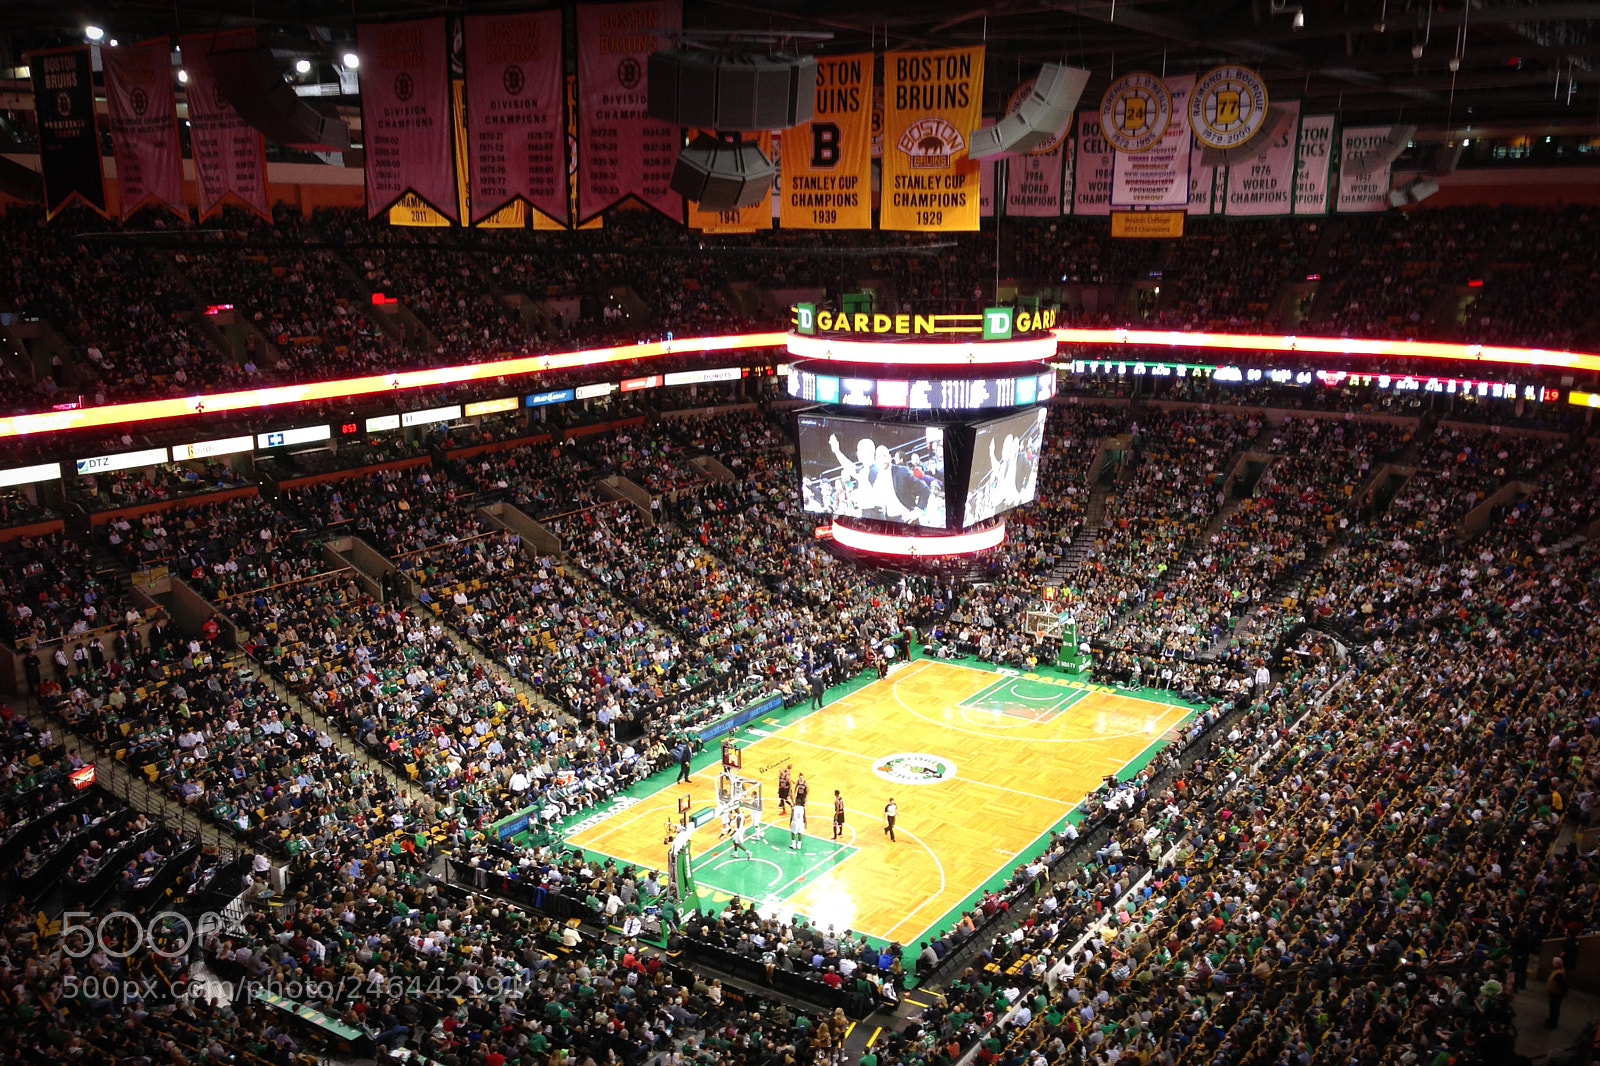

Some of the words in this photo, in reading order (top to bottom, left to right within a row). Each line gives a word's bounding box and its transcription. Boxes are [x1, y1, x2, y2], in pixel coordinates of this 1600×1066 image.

[600, 9, 657, 30] BOSTON
[600, 34, 658, 55] BRUINS
[816, 60, 861, 87] STON
[897, 53, 971, 83] BOSTON
[45, 73, 78, 89] BRUINS
[603, 94, 647, 105] DIVISIO
[817, 87, 860, 114] UINS
[896, 82, 969, 110] BRUINS
[1193, 72, 1221, 117] RAYMOND
[384, 106, 426, 117] DIVISION
[490, 100, 538, 110] DIVISION
[1220, 101, 1238, 116] 77
[485, 113, 547, 125] CHAMPIONS
[596, 109, 648, 121] CHAMPIO
[1127, 108, 1143, 121] 24
[378, 117, 432, 129] CHAMPIONS
[900, 120, 963, 149] BOSTON
[1202, 126, 1251, 144] 1979-2000
[1302, 127, 1329, 141] TON
[812, 127, 839, 165] B
[1300, 143, 1325, 157] TICS
[912, 155, 948, 168] BRUINS
[1026, 171, 1044, 182] 1986
[1251, 165, 1271, 178] 1976
[792, 177, 835, 190] STANLEY
[838, 176, 858, 189] CUP
[894, 175, 942, 190] STANLEY
[944, 174, 966, 189] CUP
[1021, 183, 1049, 195] WORLD
[1243, 179, 1277, 190] WORLD
[1350, 184, 1378, 193] WORLD
[791, 193, 858, 208] CHAMPIONS
[893, 193, 966, 208] CHAMPIONS
[1010, 195, 1057, 207] CHAMPIONS
[1078, 195, 1111, 204] CHAMP
[1230, 192, 1287, 204] CHAMPIONS
[1341, 194, 1387, 204] CHAMPIONS
[411, 211, 427, 223] 2011
[720, 211, 741, 225] 1941
[813, 210, 837, 224] 1939
[916, 211, 943, 226] 1929
[817, 309, 935, 334] GARDEN
[987, 312, 1010, 335] TD
[1016, 309, 1056, 332] GARD
[703, 371, 732, 381] DONUTS
[1545, 389, 1559, 402] 19
[89, 457, 109, 468] DTZ
[1022, 672, 1117, 694] GARDEN
